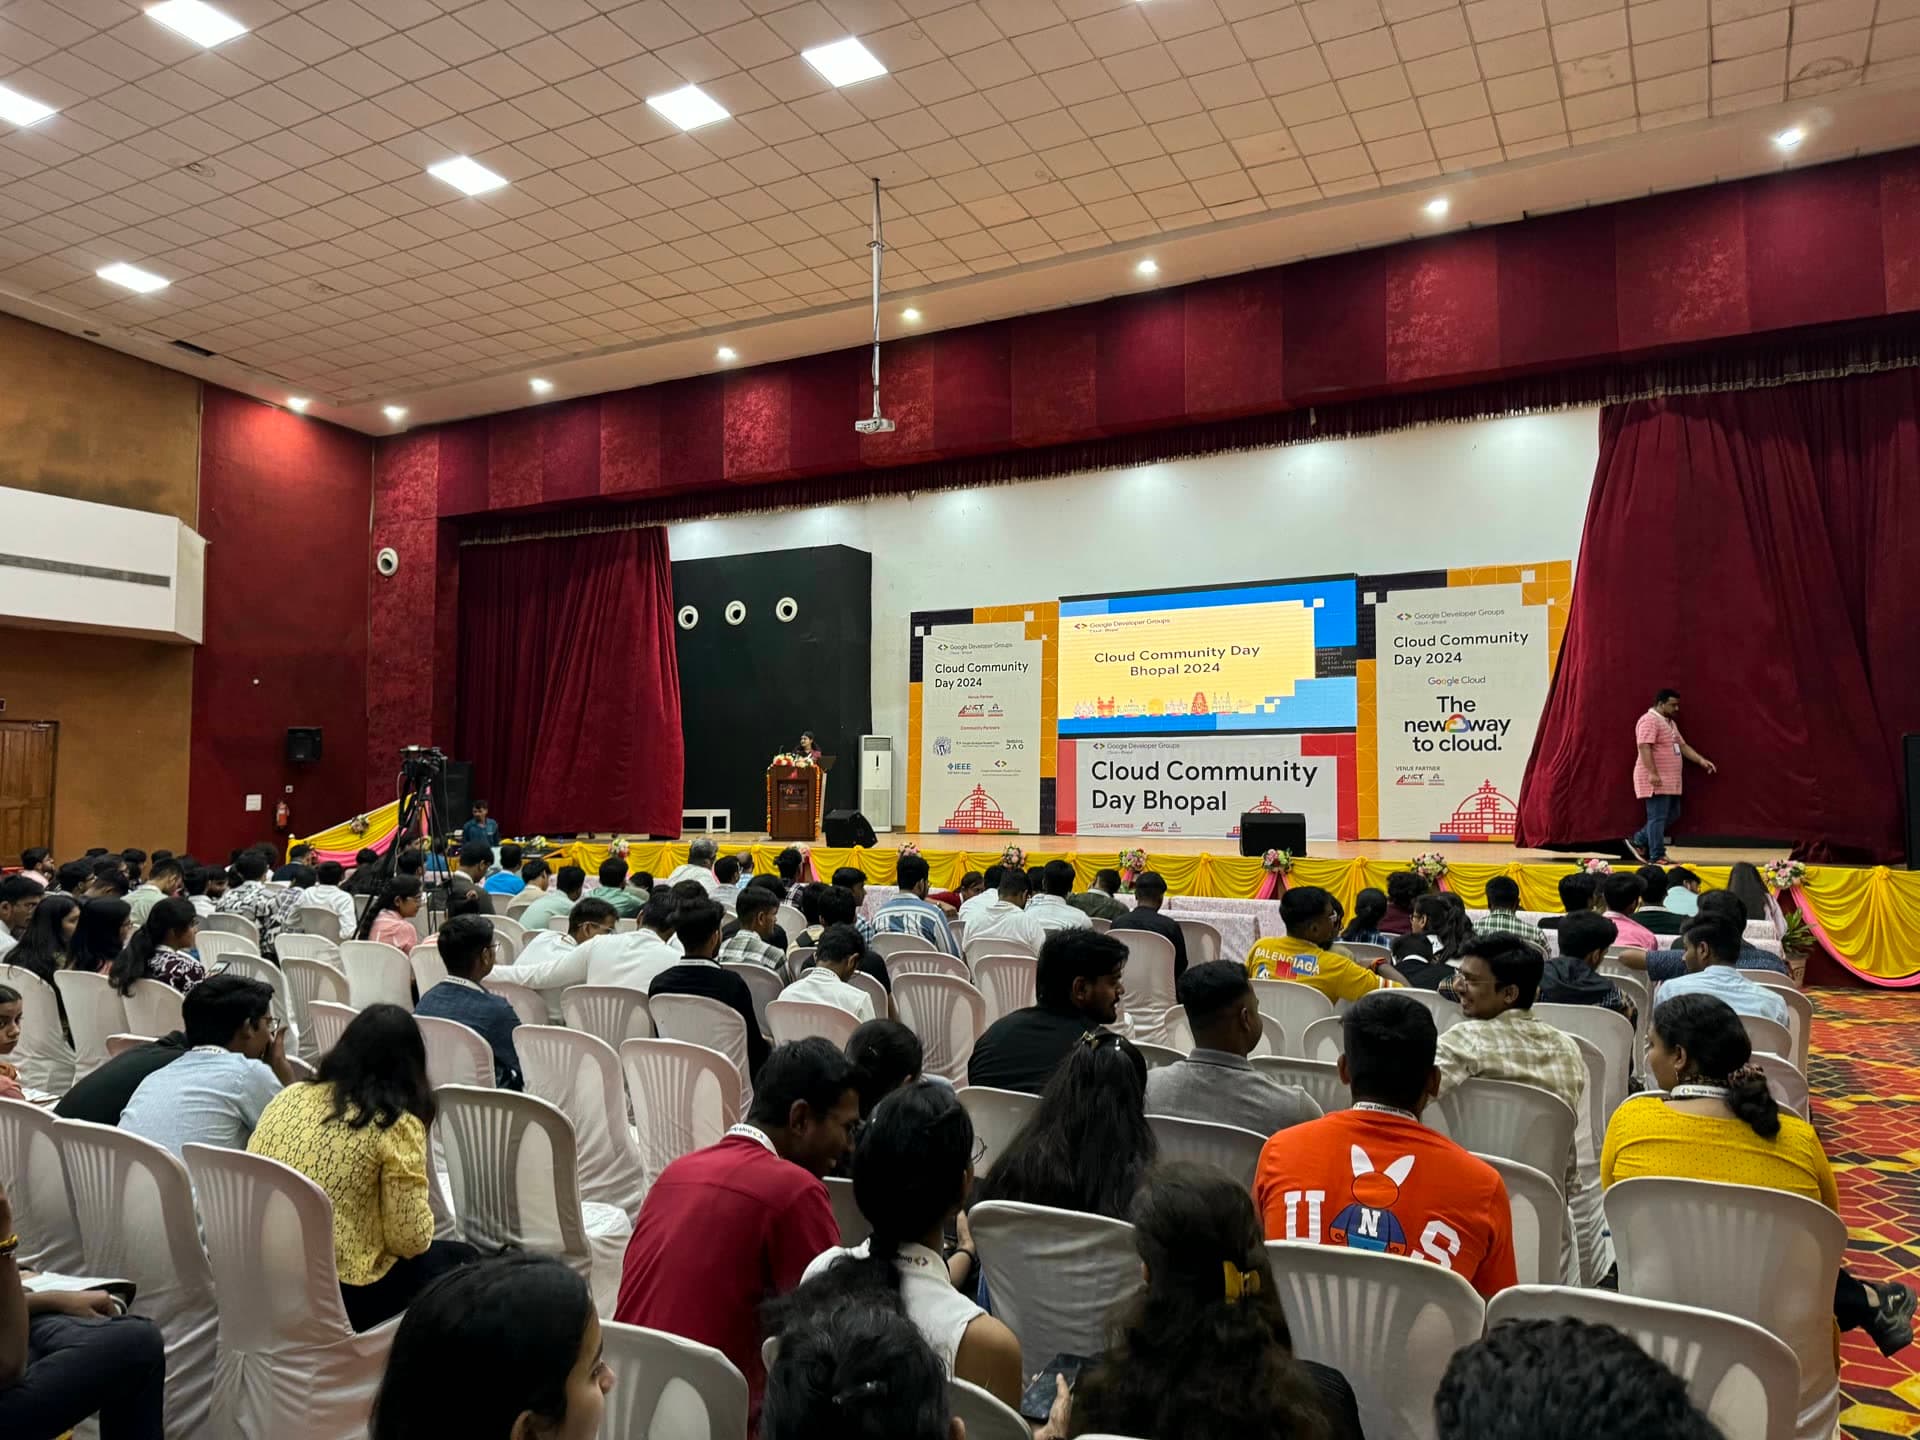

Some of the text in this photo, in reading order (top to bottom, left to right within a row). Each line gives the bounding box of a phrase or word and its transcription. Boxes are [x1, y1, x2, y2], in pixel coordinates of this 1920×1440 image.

[1415, 608, 1505, 620] Google Developer Groups
[1114, 619, 1146, 627] Developer
[1394, 631, 1528, 648] Cloud Community
[1094, 645, 1261, 663] Cloud Community Day
[1394, 652, 1462, 668] Day 2024
[935, 661, 1029, 674] Cloud Community
[1130, 662, 1221, 677] Bhopal 2024
[935, 677, 982, 690] Day 2024
[1428, 675, 1486, 686] Google Cloud
[1436, 696, 1476, 713] The
[1404, 718, 1511, 736] new way
[1106, 742, 1128, 750] Google
[1128, 742, 1158, 750] Developer
[1412, 734, 1502, 752] to cloud.
[1092, 760, 1318, 788] Cloud Community
[1092, 789, 1227, 816] Day Bhopal
[1254, 947, 1320, 976] BALENCIAGA
[1284, 1190, 1461, 1269] U N S
